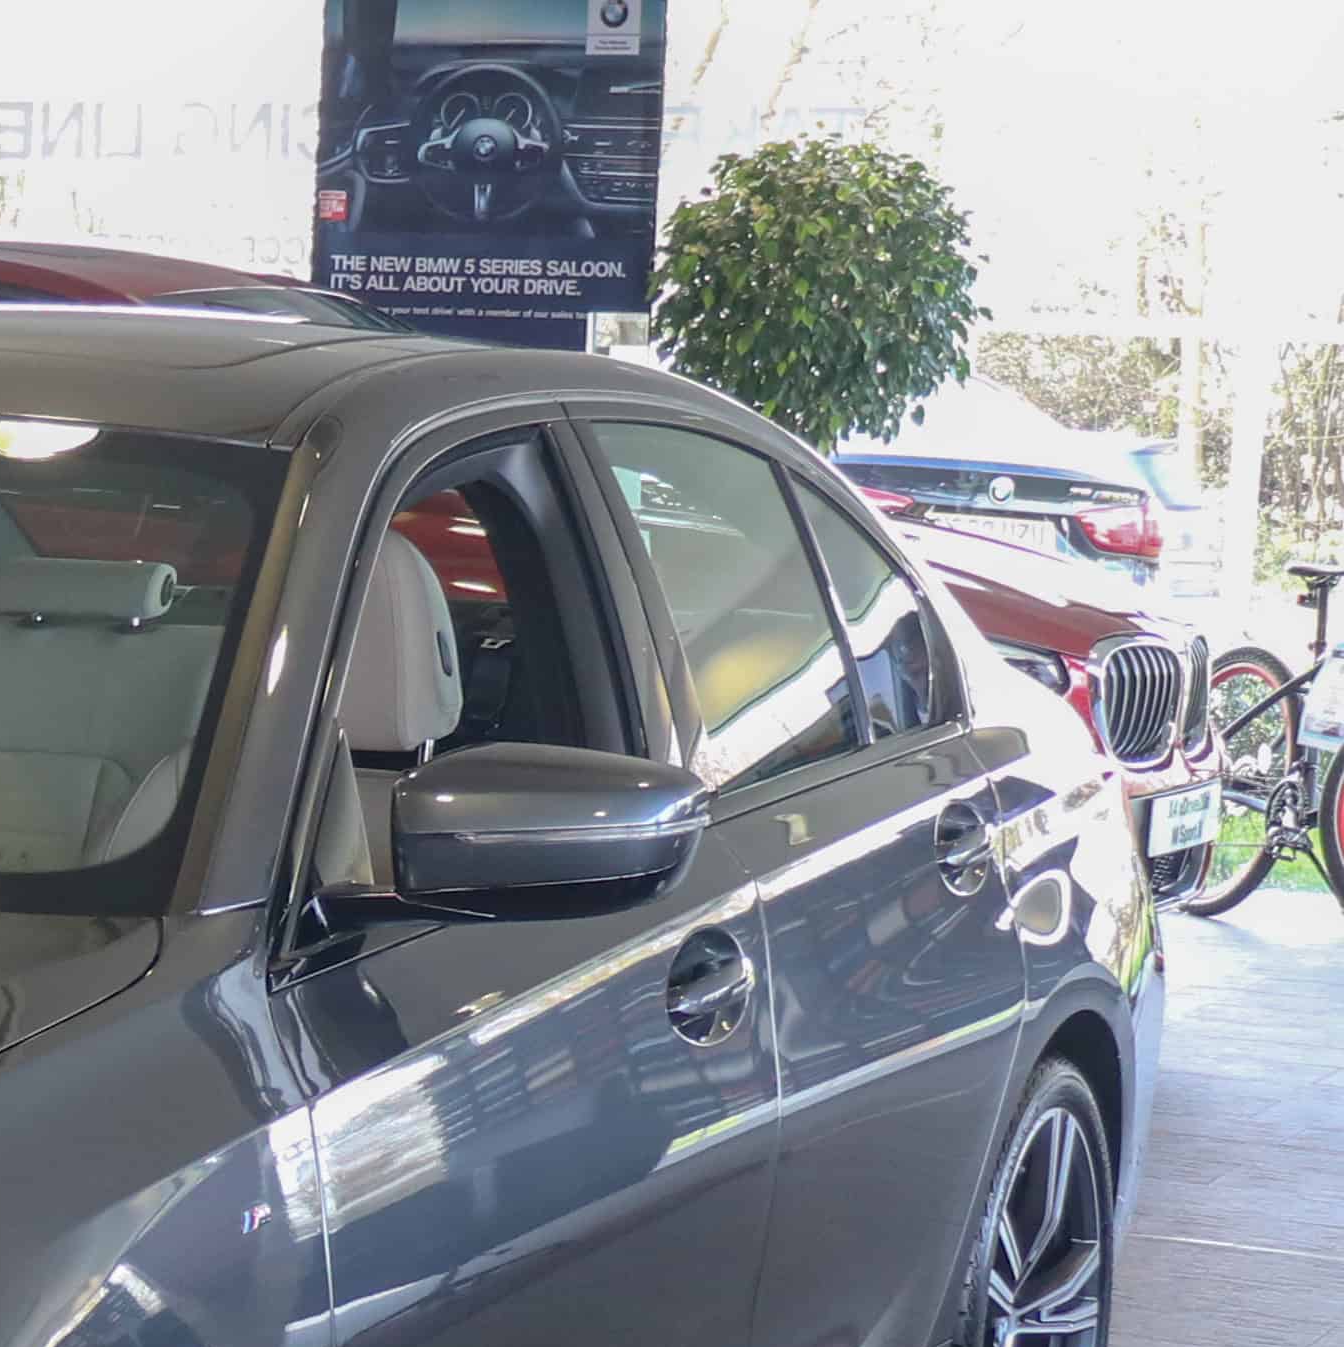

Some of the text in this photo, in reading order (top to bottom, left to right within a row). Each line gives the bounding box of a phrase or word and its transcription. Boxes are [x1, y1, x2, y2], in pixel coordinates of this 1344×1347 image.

[330, 254, 626, 279] THE NEW BMW 5 SERIES SALOON.
[329, 273, 582, 297] IT'S ALL ABOUT YOUR DRIVE.
